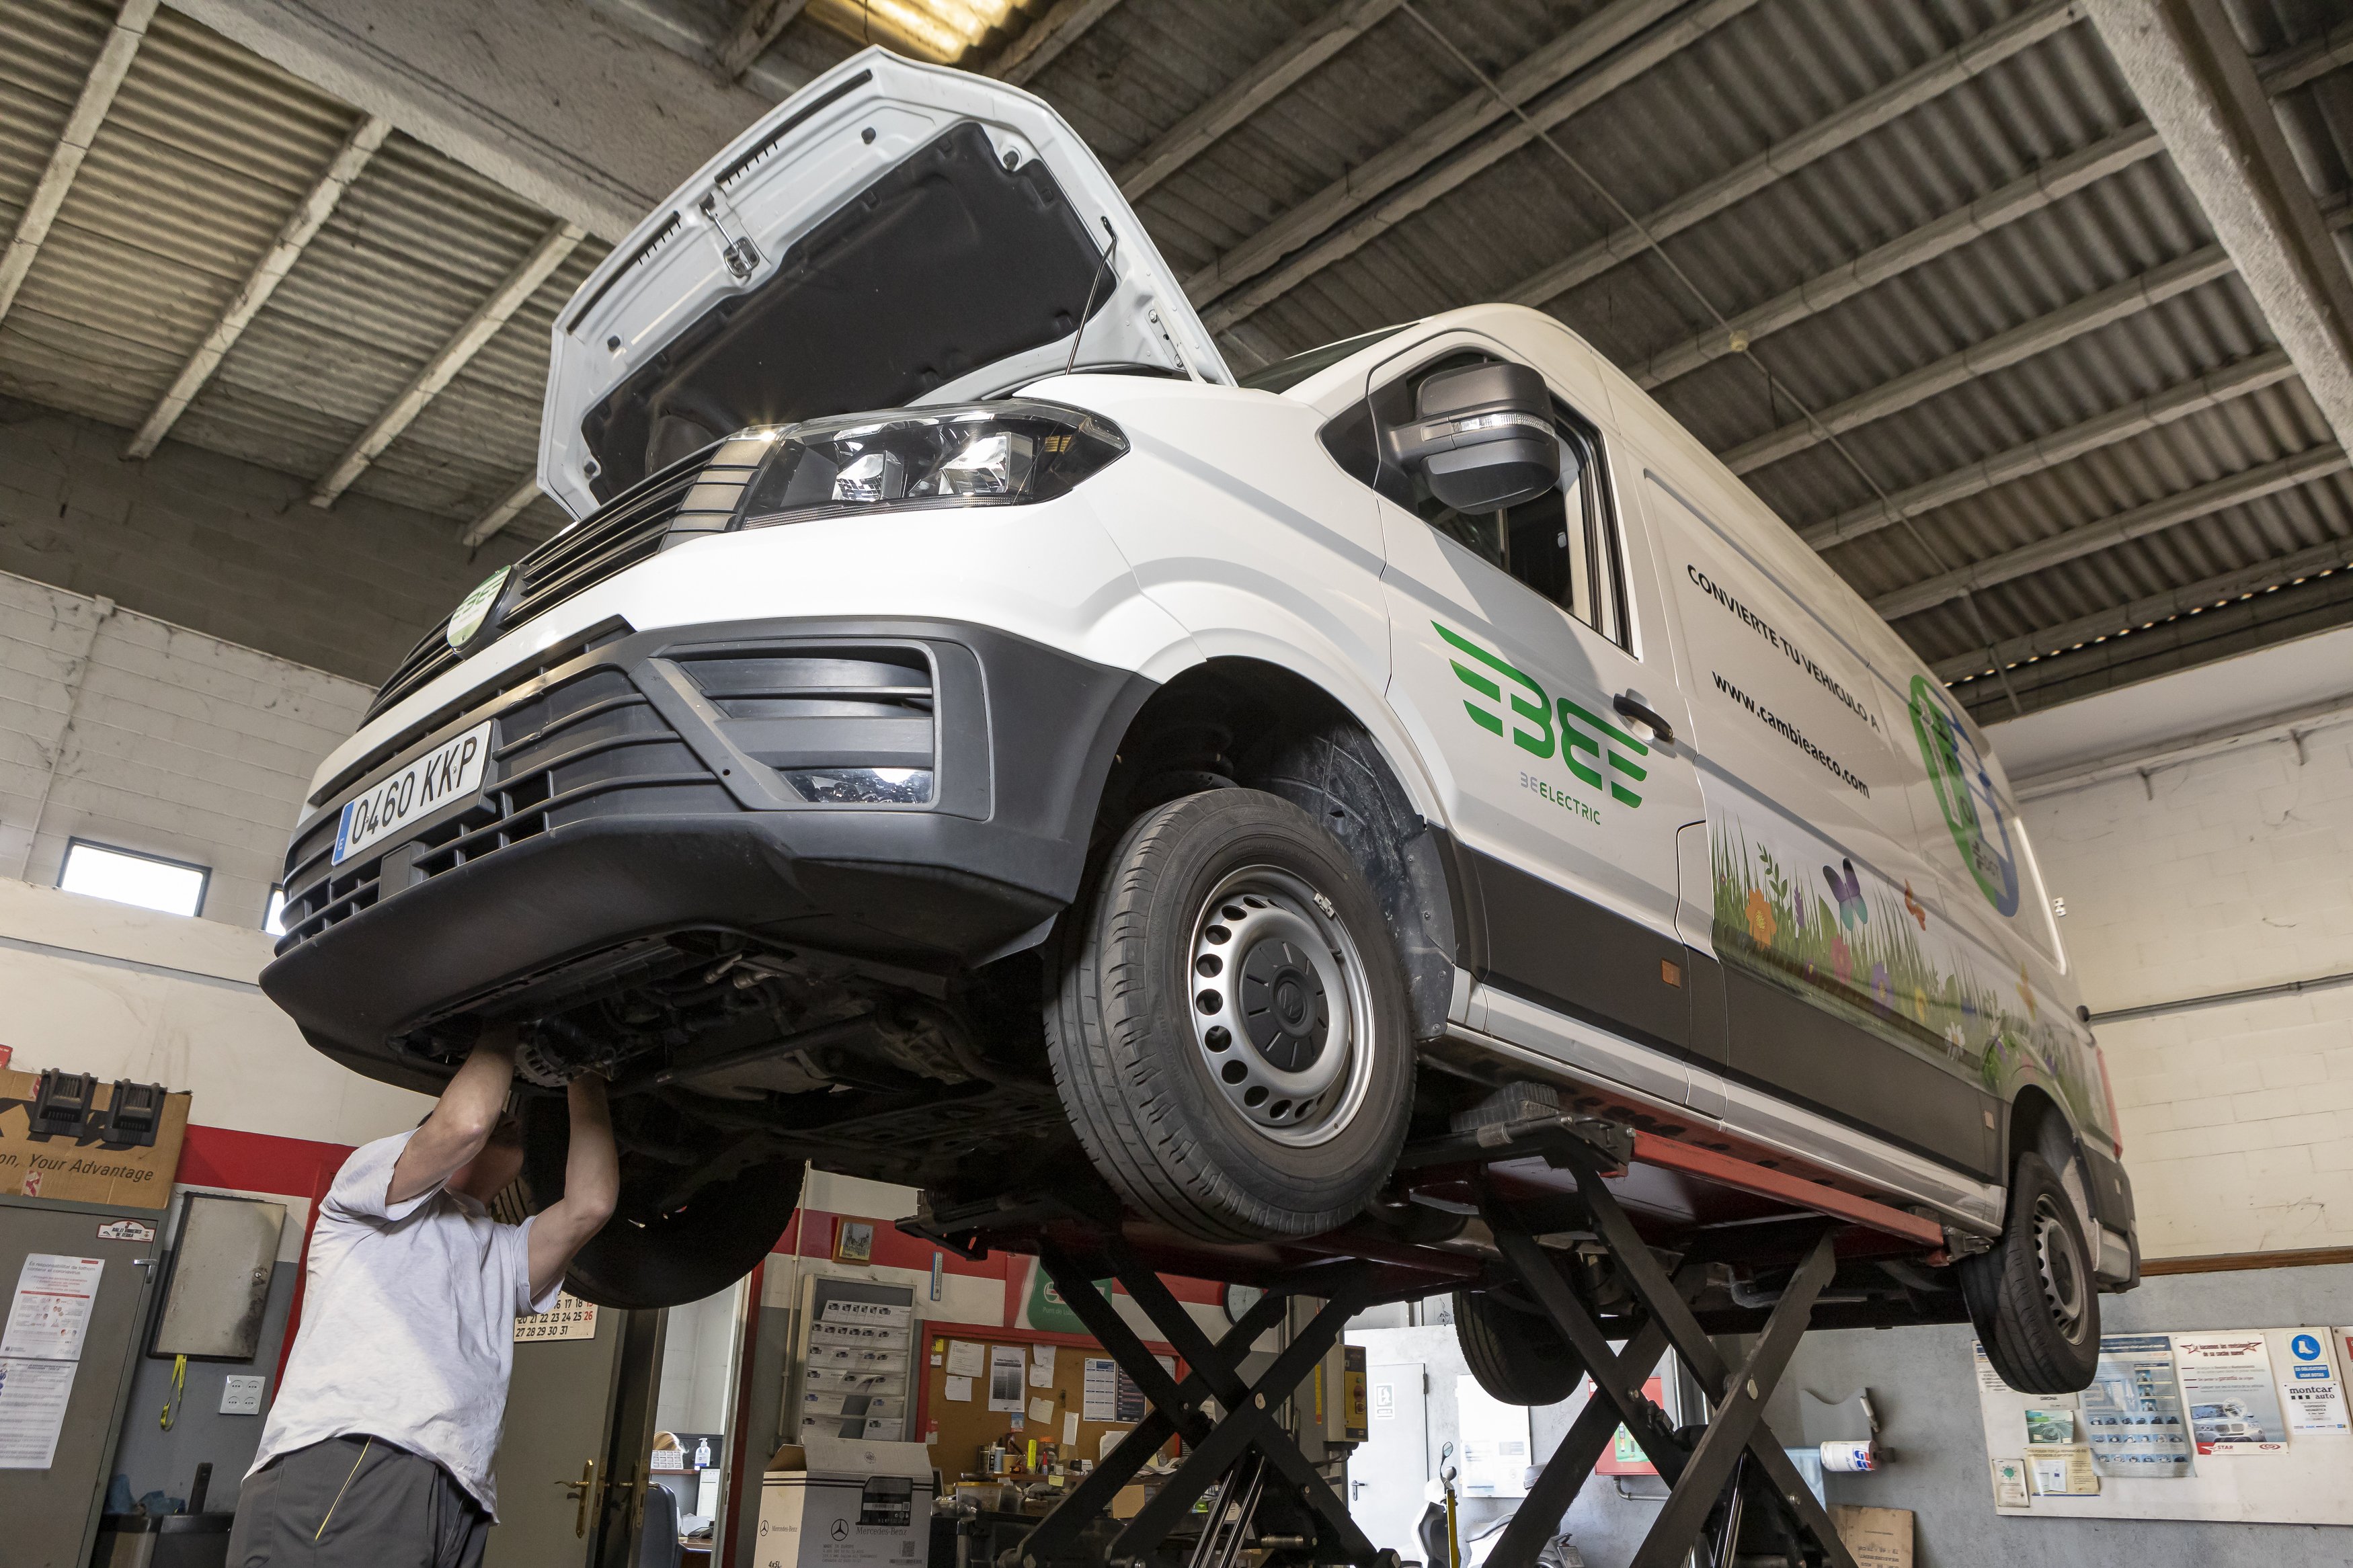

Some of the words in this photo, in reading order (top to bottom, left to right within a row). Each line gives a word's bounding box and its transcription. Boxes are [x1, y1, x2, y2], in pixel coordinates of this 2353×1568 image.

[1687, 565, 1779, 649] CONVIERTE
[1780, 636, 1800, 665] TU
[1802, 655, 1868, 721] VEHICULO
[1871, 714, 1880, 733] A
[1712, 671, 1871, 798] www.cambieaeco.com
[352, 772, 415, 845] 0460
[420, 737, 477, 807] KKP
[338, 837, 344, 851] E
[30, 1154, 67, 1170] Your
[69, 1159, 154, 1182] Advantage
[565, 1299, 573, 1309] 17
[575, 1298, 583, 1307] 18
[530, 1315, 537, 1323] 21
[539, 1313, 548, 1323] 22
[551, 1313, 559, 1322] 23
[561, 1313, 571, 1321] 24
[573, 1311, 582, 1321] 25
[584, 1311, 593, 1321] 26
[516, 1327, 526, 1337] 27
[526, 1327, 535, 1336] 28
[537, 1327, 546, 1336] 29
[547, 1326, 557, 1335] 30
[559, 1326, 568, 1335] 31
[772, 1525, 798, 1533] Mercedes-Benz
[856, 1526, 907, 1536] Mercedes-Benz
